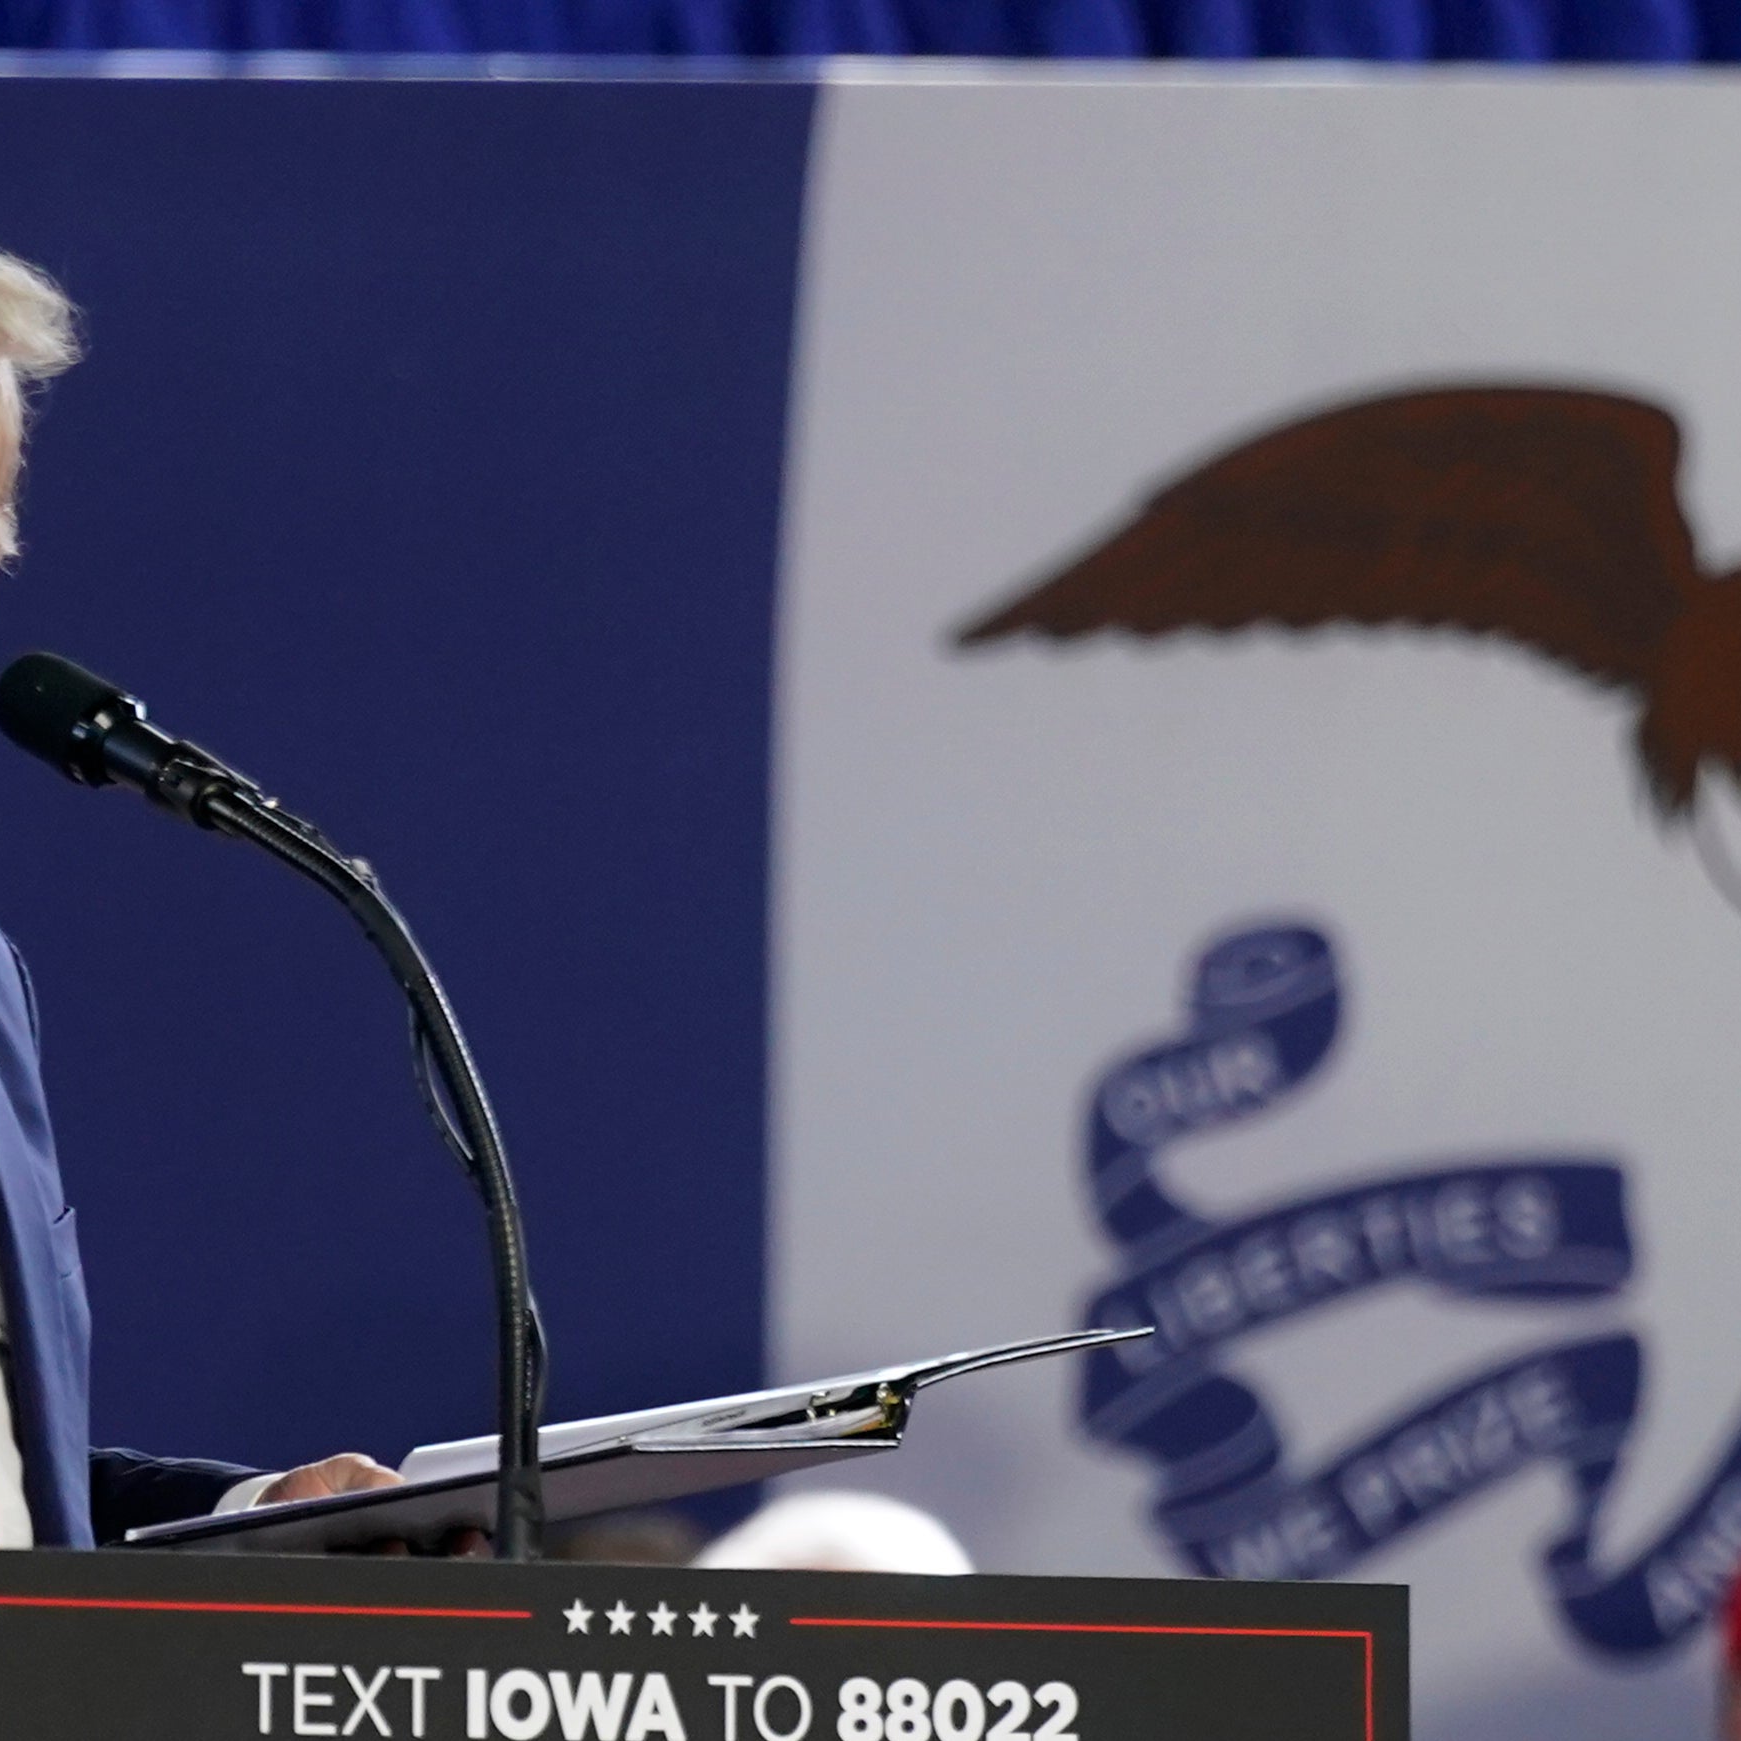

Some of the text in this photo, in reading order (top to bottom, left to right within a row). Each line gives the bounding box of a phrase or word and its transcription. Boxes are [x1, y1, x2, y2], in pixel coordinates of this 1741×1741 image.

[1101, 1032, 1281, 1144] OUR
[1097, 1170, 1559, 1374] LIBERTIES
[1201, 1358, 1579, 1580] WE PRIZE
[241, 1662, 442, 1738] TEXT
